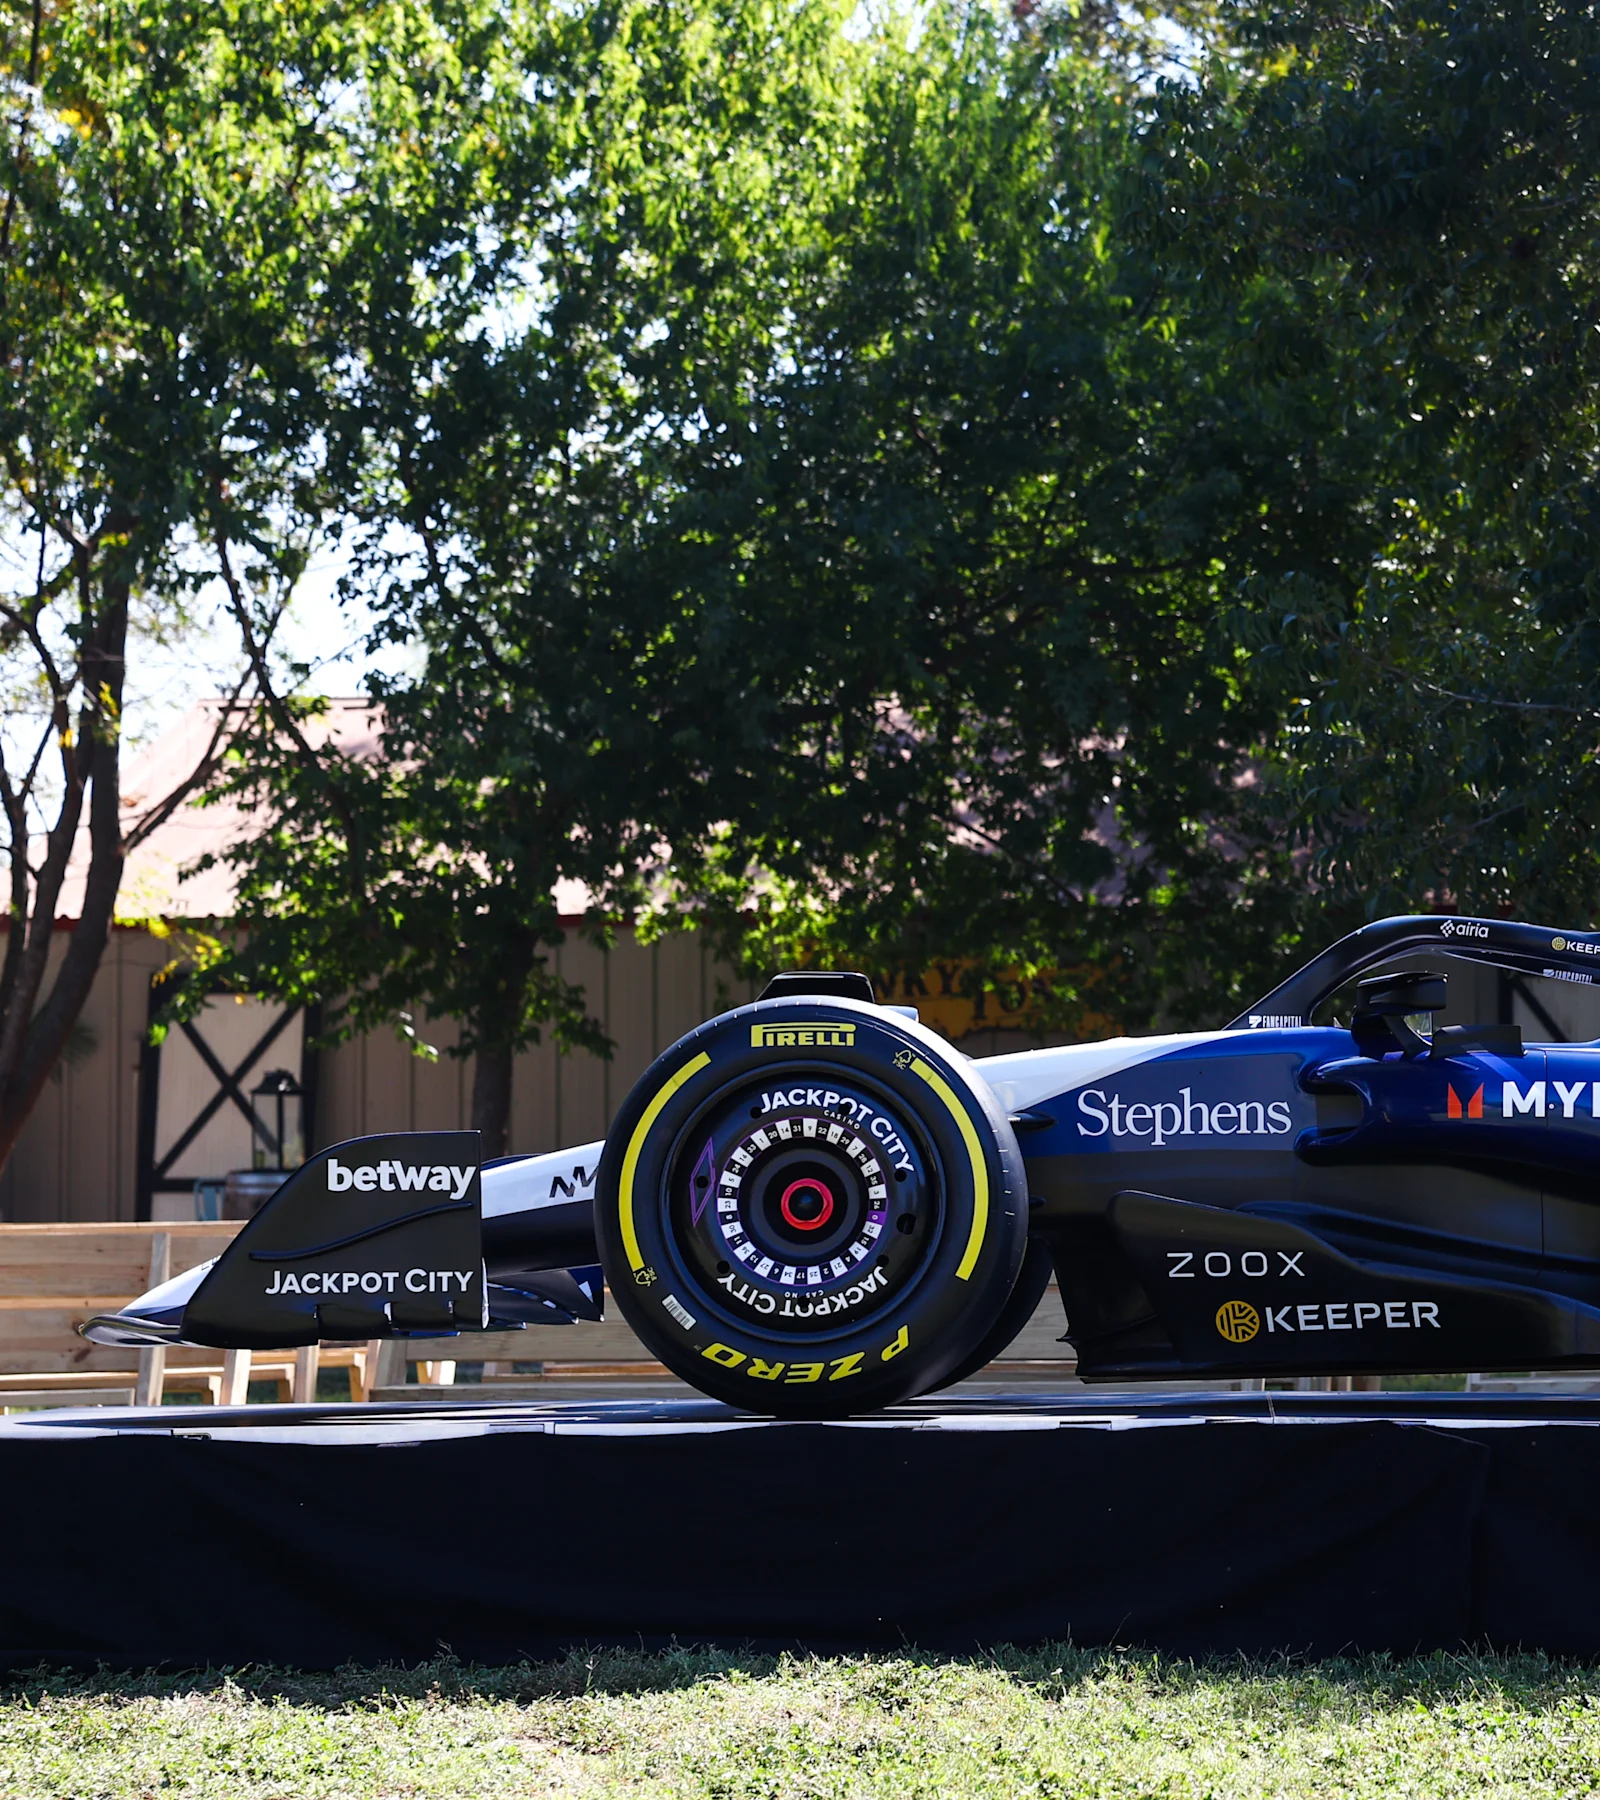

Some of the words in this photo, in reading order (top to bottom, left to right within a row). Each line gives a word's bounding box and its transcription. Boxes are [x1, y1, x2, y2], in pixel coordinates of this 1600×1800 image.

[1455, 922, 1490, 939] airia
[751, 1022, 857, 1048] PIRELLI
[823, 1109, 861, 1131] CASINO
[1076, 1086, 1292, 1147] Stephens
[761, 1088, 874, 1122] JACKPOT
[870, 1116, 915, 1173] CITY
[792, 1124, 802, 1133] 31
[817, 1126, 828, 1135] 22
[767, 1130, 778, 1140] 20
[830, 1130, 839, 1140] 18
[840, 1136, 850, 1145] 29
[746, 1143, 757, 1154] 33
[739, 1154, 748, 1162] 16
[858, 1153, 868, 1164] 28
[731, 1163, 741, 1174] 24
[865, 1164, 874, 1174] 12
[327, 1158, 478, 1200] betway
[869, 1175, 878, 1186] 35
[724, 1187, 733, 1196] 10
[724, 1200, 732, 1209] 23
[873, 1200, 881, 1210] 26
[728, 1224, 737, 1234] 30
[866, 1224, 875, 1234] 32
[733, 1236, 743, 1245] 11
[860, 1236, 870, 1246] 15
[741, 1245, 751, 1255] 36
[853, 1246, 862, 1255] 19
[749, 1254, 759, 1264] 13
[759, 1262, 770, 1270] 27
[833, 1261, 843, 1270] 21
[1166, 1250, 1306, 1279] ZOOX
[774, 1267, 780, 1275] 6
[809, 1270, 819, 1278] 25
[822, 1267, 830, 1275] 2
[265, 1270, 399, 1295] JACKPOT
[405, 1268, 474, 1293] CITY
[717, 1272, 777, 1314] CITY
[778, 1266, 890, 1318] JACKPOT
[784, 1289, 825, 1299] CASNO
[1266, 1301, 1441, 1332] KEEPER
[881, 1325, 909, 1361] P
[701, 1343, 866, 1384] ZERO
